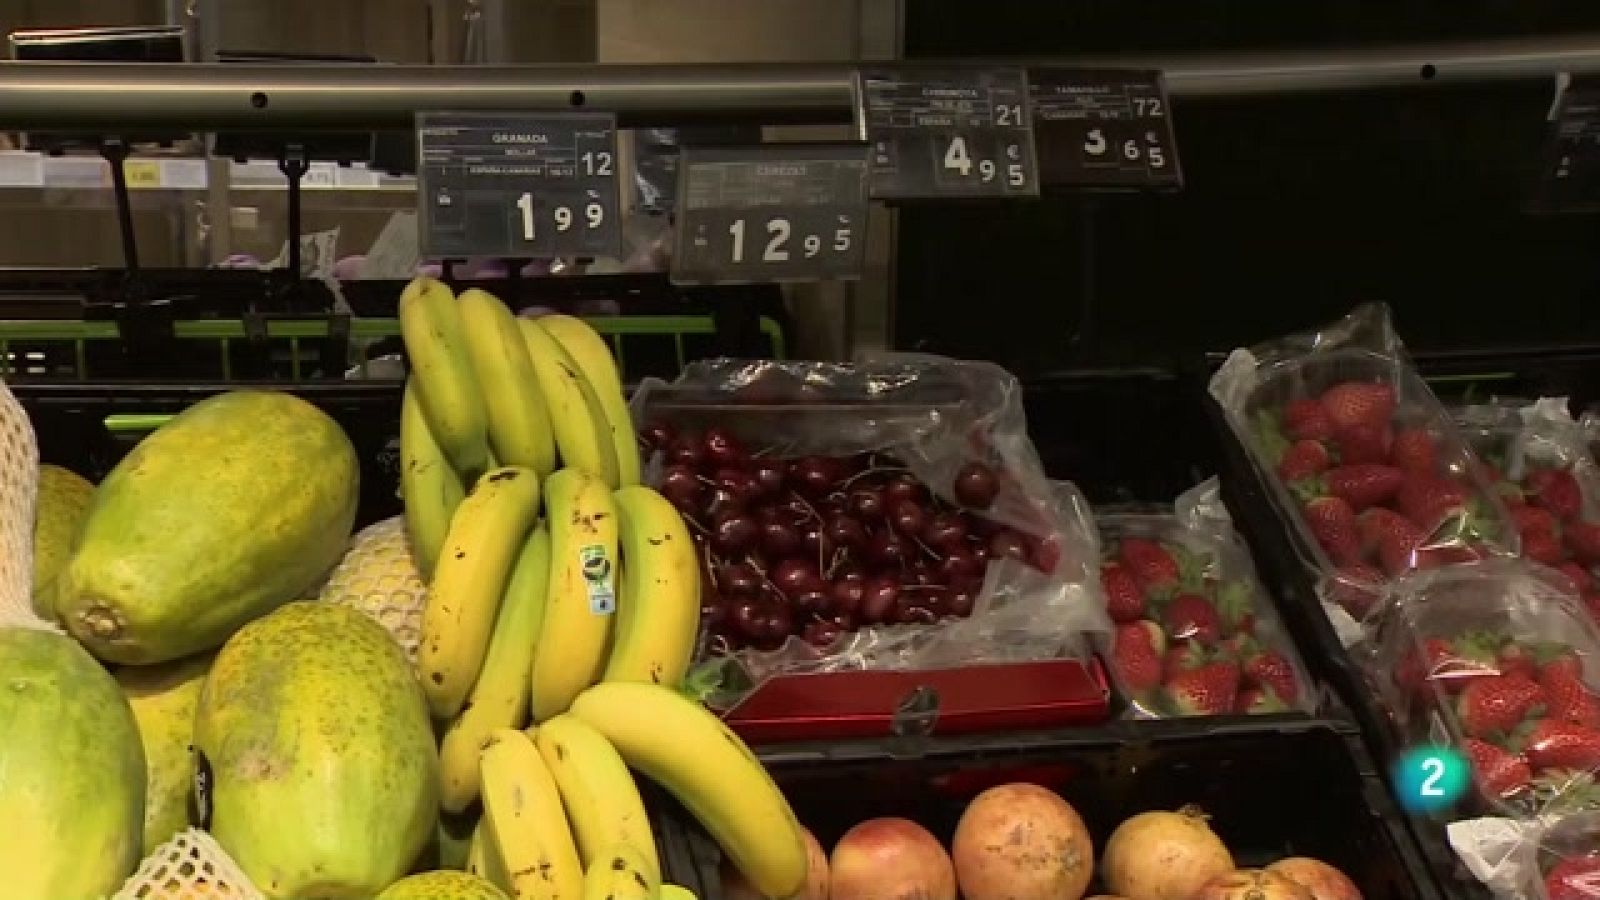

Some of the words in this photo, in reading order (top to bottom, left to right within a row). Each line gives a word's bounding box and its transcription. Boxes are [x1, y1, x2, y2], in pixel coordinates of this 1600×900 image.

[996, 104, 1022, 126] 21
[1132, 97, 1164, 118] 72
[491, 133, 549, 145] GRANADA
[582, 152, 614, 177] 12
[944, 136, 972, 176] 4
[517, 192, 536, 241] 1
